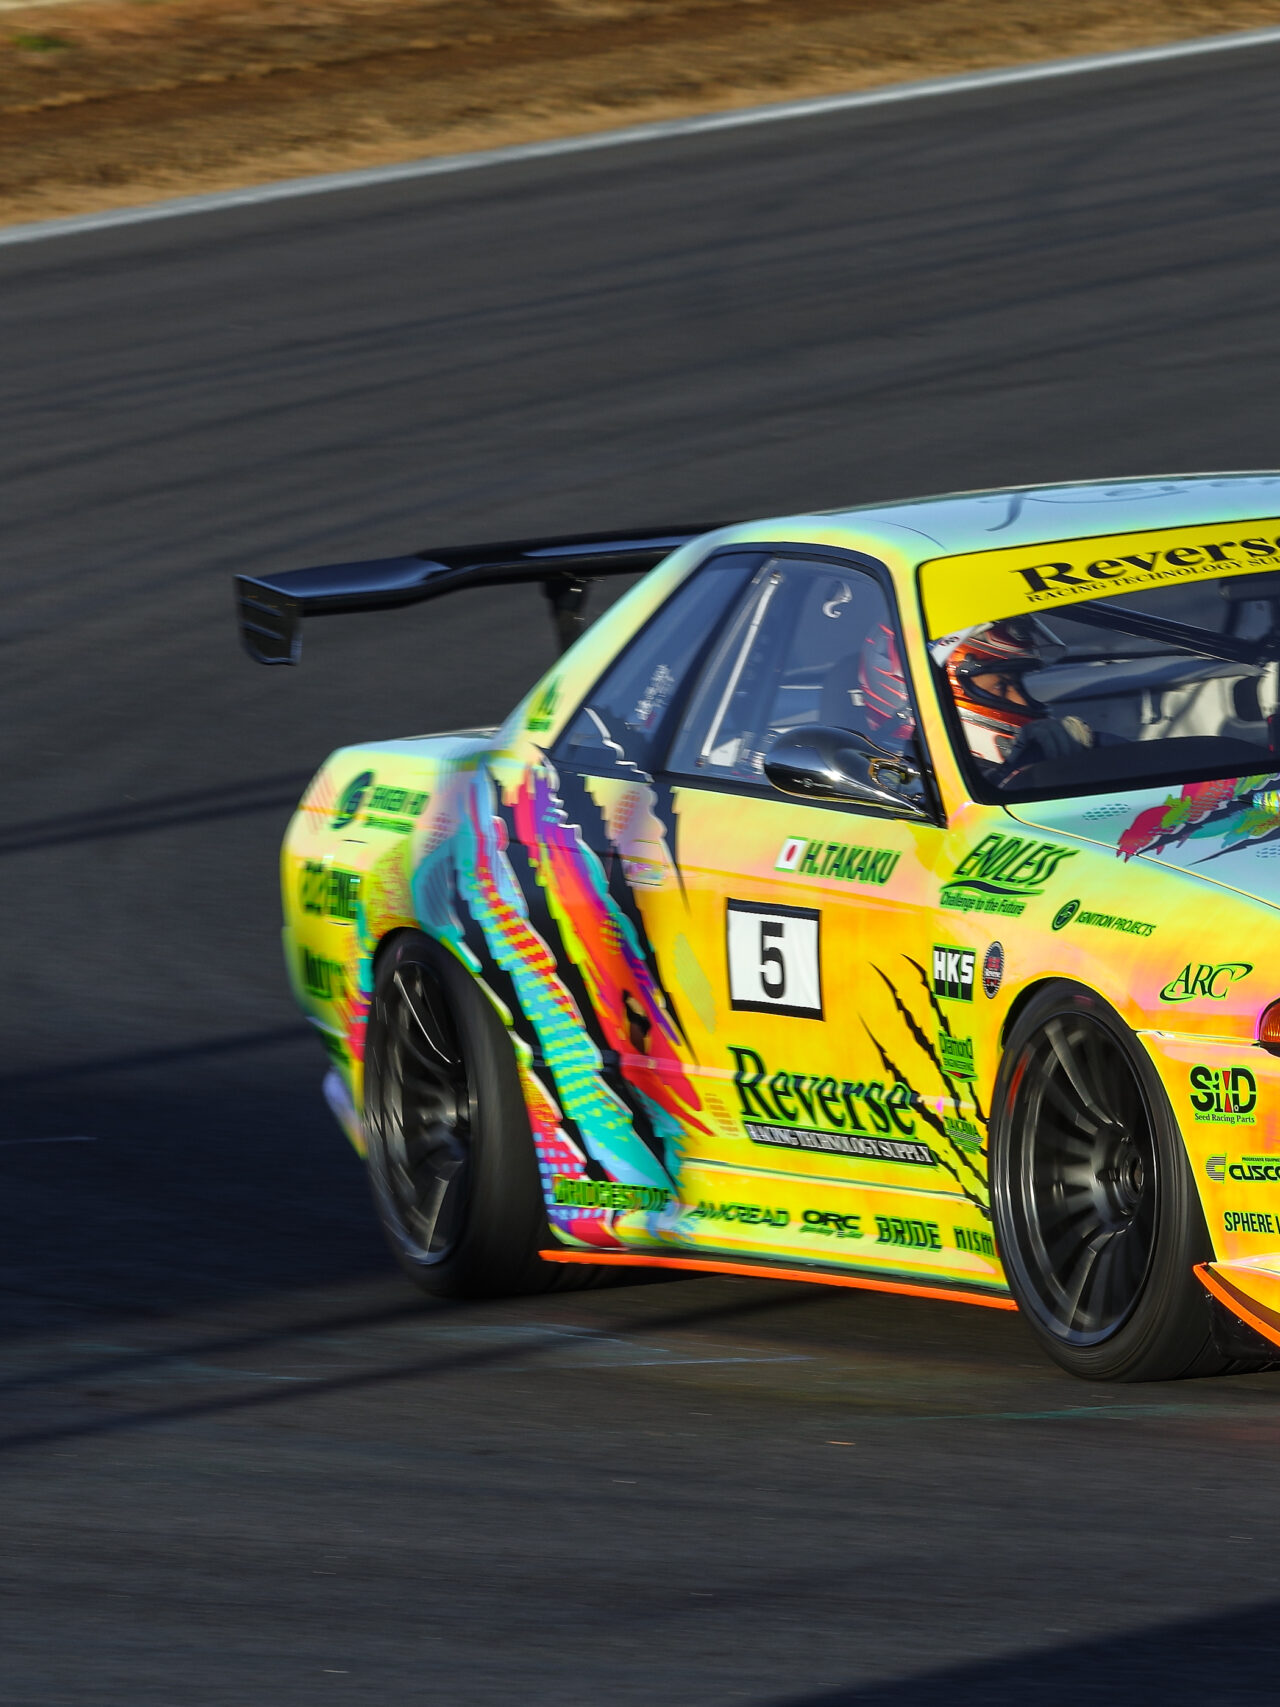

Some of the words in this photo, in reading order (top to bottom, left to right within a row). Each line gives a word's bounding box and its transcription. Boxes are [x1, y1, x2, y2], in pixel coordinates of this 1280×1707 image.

[1026, 581, 1107, 604] RACING
[1111, 560, 1244, 588] TECHNOLOGY
[799, 841, 901, 885] H.TAKAKU
[954, 835, 1080, 887] ENDLESS
[1076, 911, 1114, 931] IGNITION
[1112, 917, 1157, 937] PROJECTS
[760, 920, 785, 999] 5
[933, 949, 976, 986] HKS
[1168, 963, 1238, 999] ARC
[727, 1045, 916, 1136] Reverse
[1195, 1113, 1211, 1121] Seed
[1212, 1114, 1235, 1124] Racing
[1236, 1115, 1255, 1123] Parts
[802, 1209, 861, 1231] ORC
[874, 1216, 942, 1250] BRIDE
[1224, 1211, 1274, 1234] SPHERE
[954, 1228, 997, 1257] NISM
